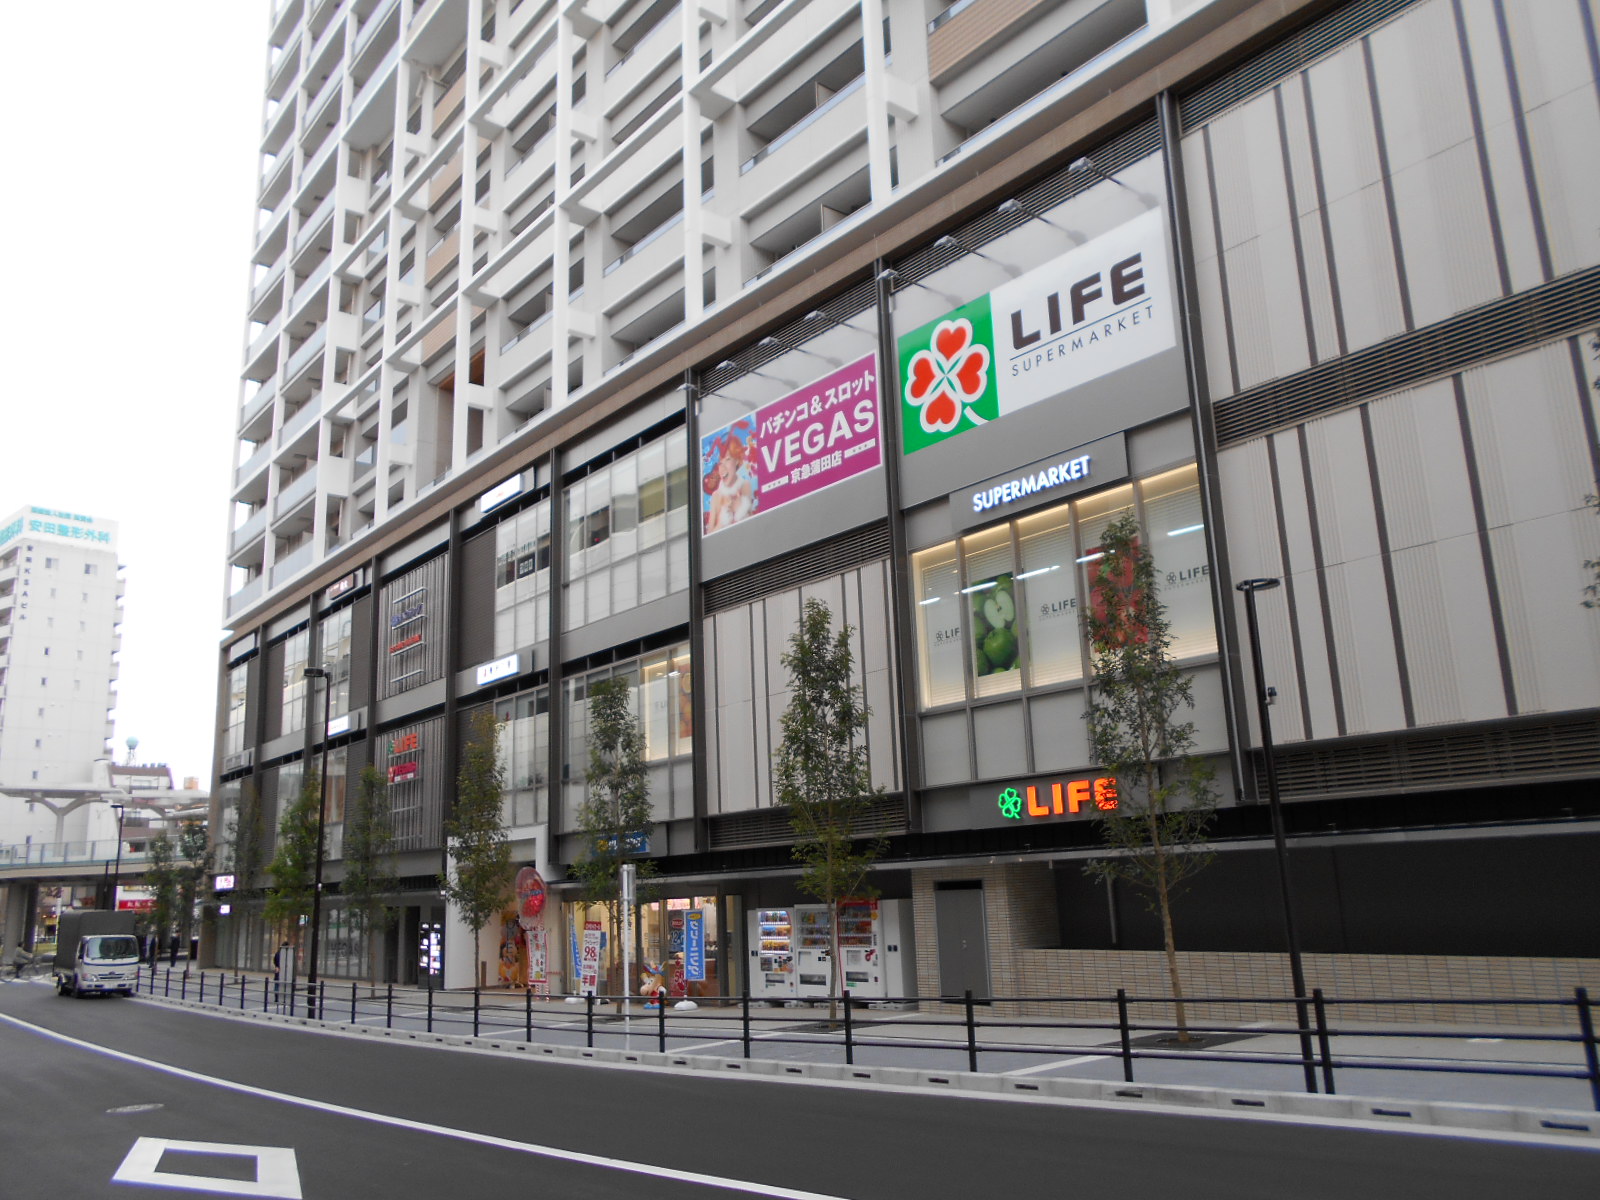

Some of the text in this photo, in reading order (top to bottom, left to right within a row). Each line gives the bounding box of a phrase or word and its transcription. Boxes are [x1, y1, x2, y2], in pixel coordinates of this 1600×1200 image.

[1010, 252, 1146, 350] LIFE
[1011, 305, 1153, 377] SUPERMARKET
[760, 369, 875, 439] パチンコ&スロット
[761, 399, 875, 473] VEGAS
[972, 454, 1091, 512] SUPERMARKET
[1179, 565, 1209, 581] LIFE
[945, 627, 960, 639] LIF
[1051, 598, 1077, 612] LIFE
[394, 733, 418, 753] LIFE
[1026, 777, 1119, 816] LIFE
[687, 920, 699, 976] クリーニング
